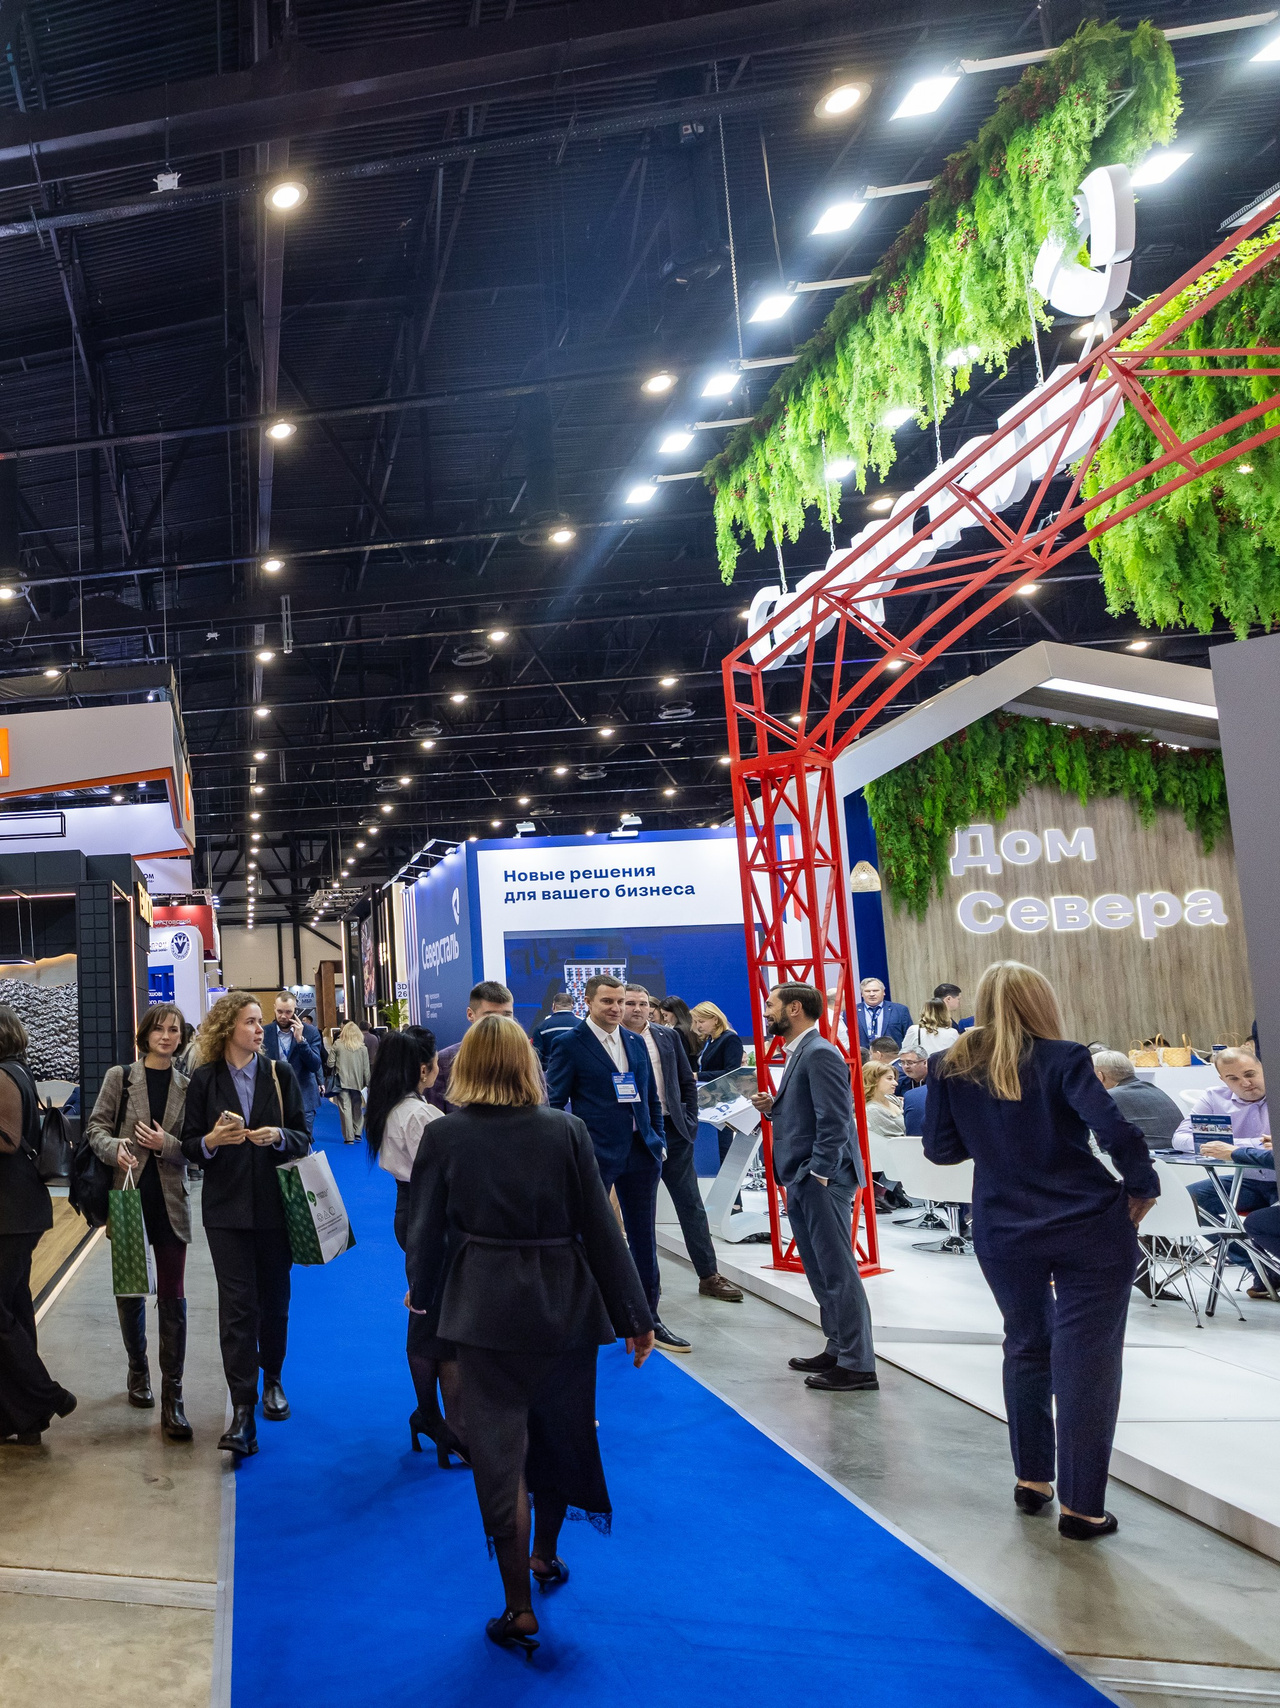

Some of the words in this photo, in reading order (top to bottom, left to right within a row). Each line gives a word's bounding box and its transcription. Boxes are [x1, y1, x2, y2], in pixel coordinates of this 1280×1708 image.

[950, 824, 1096, 875] Дом
[504, 869, 565, 882] Новые
[570, 866, 656, 883] решения
[504, 890, 537, 904] для
[542, 887, 610, 900] вашего
[615, 884, 695, 897] бизнеса
[958, 888, 1228, 939] Севера
[421, 932, 460, 976] Северсталь
